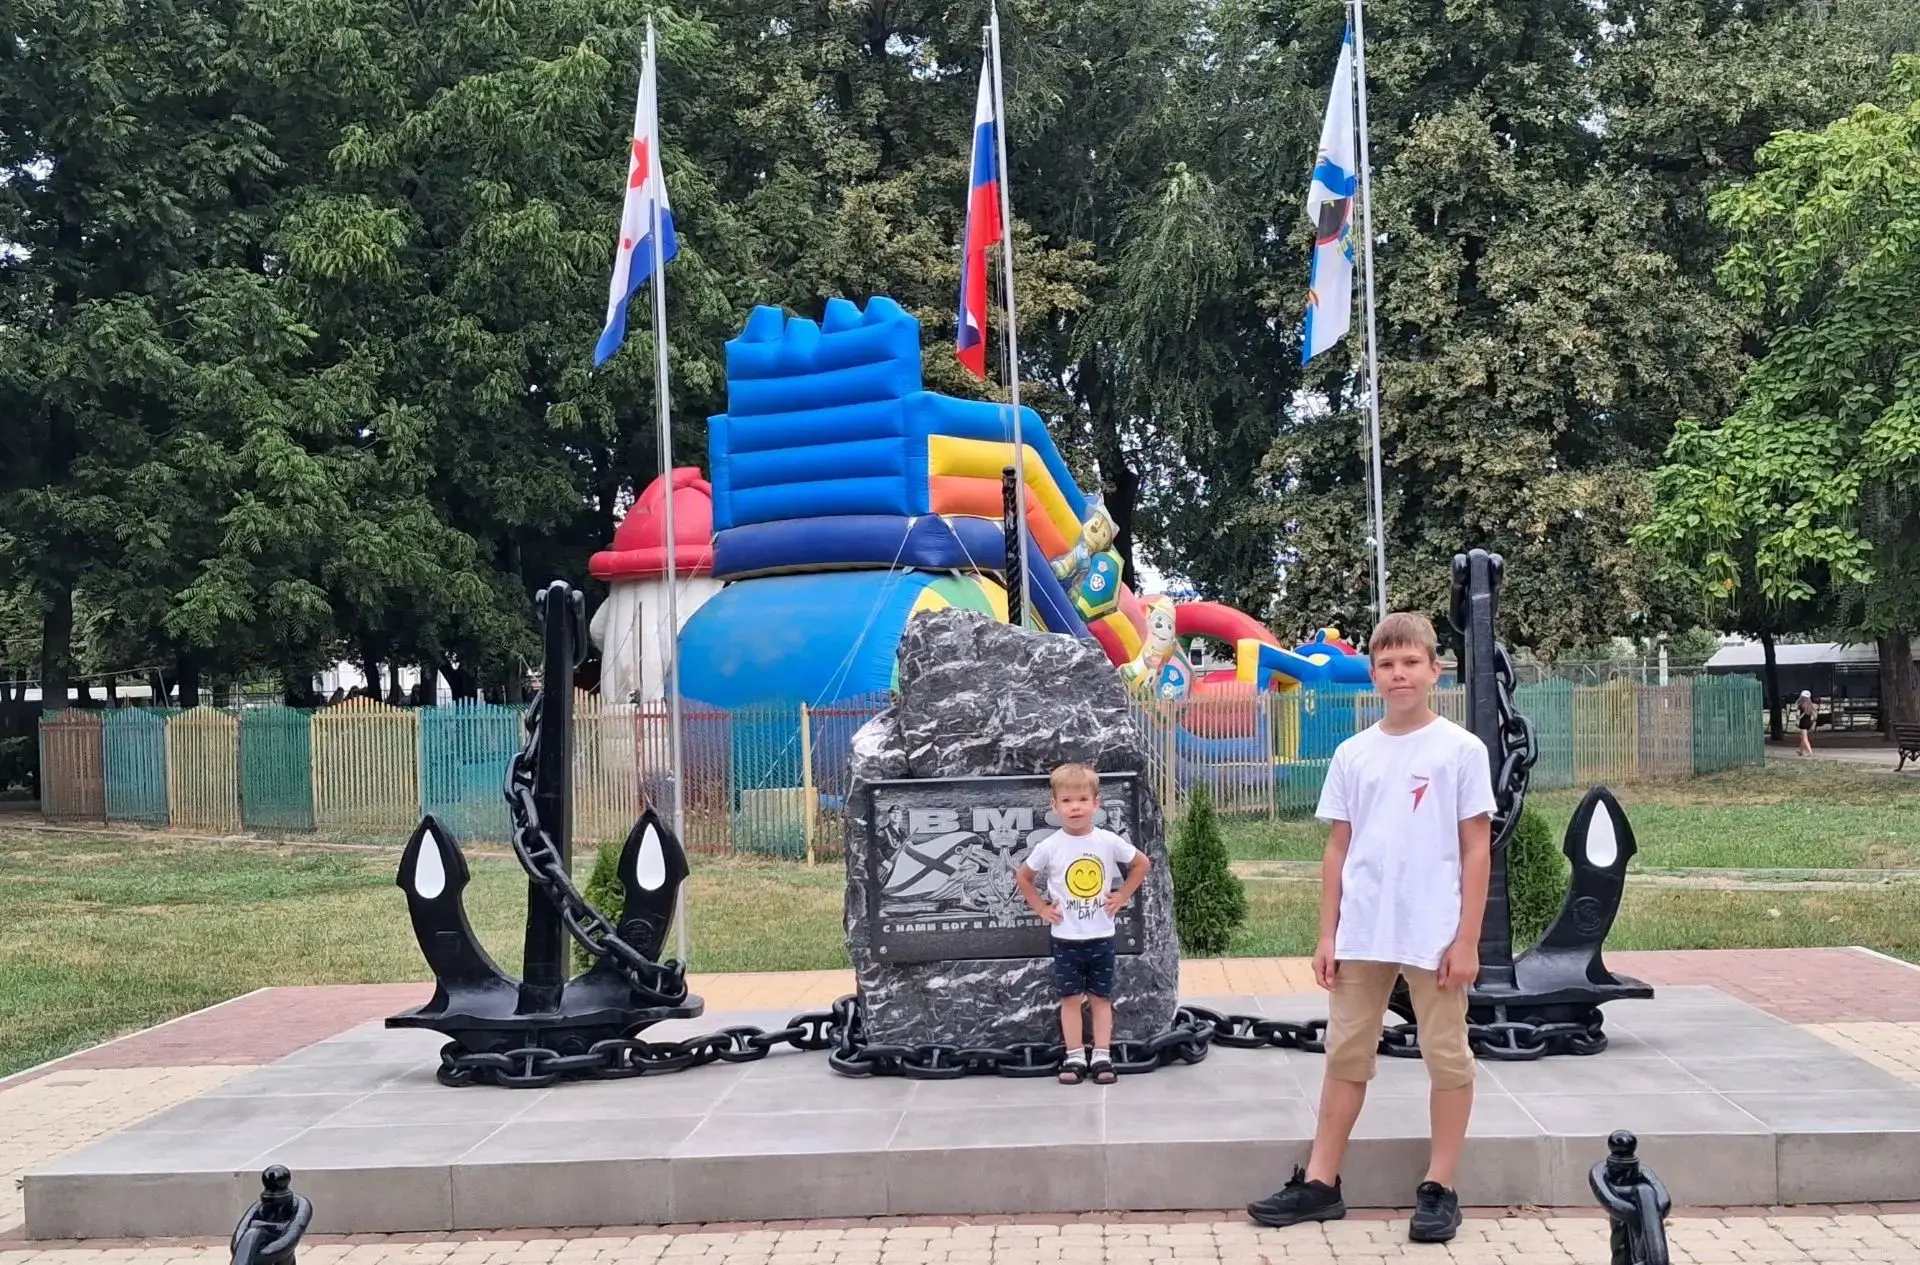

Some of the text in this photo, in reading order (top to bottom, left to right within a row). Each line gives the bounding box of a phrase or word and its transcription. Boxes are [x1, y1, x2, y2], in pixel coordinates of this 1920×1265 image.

[1093, 897, 1106, 909] AL
[1078, 909, 1097, 920] DAY
[882, 924, 891, 933] С
[895, 923, 936, 932] НАМИ
[941, 921, 968, 931] БОГ
[973, 920, 983, 929] И
